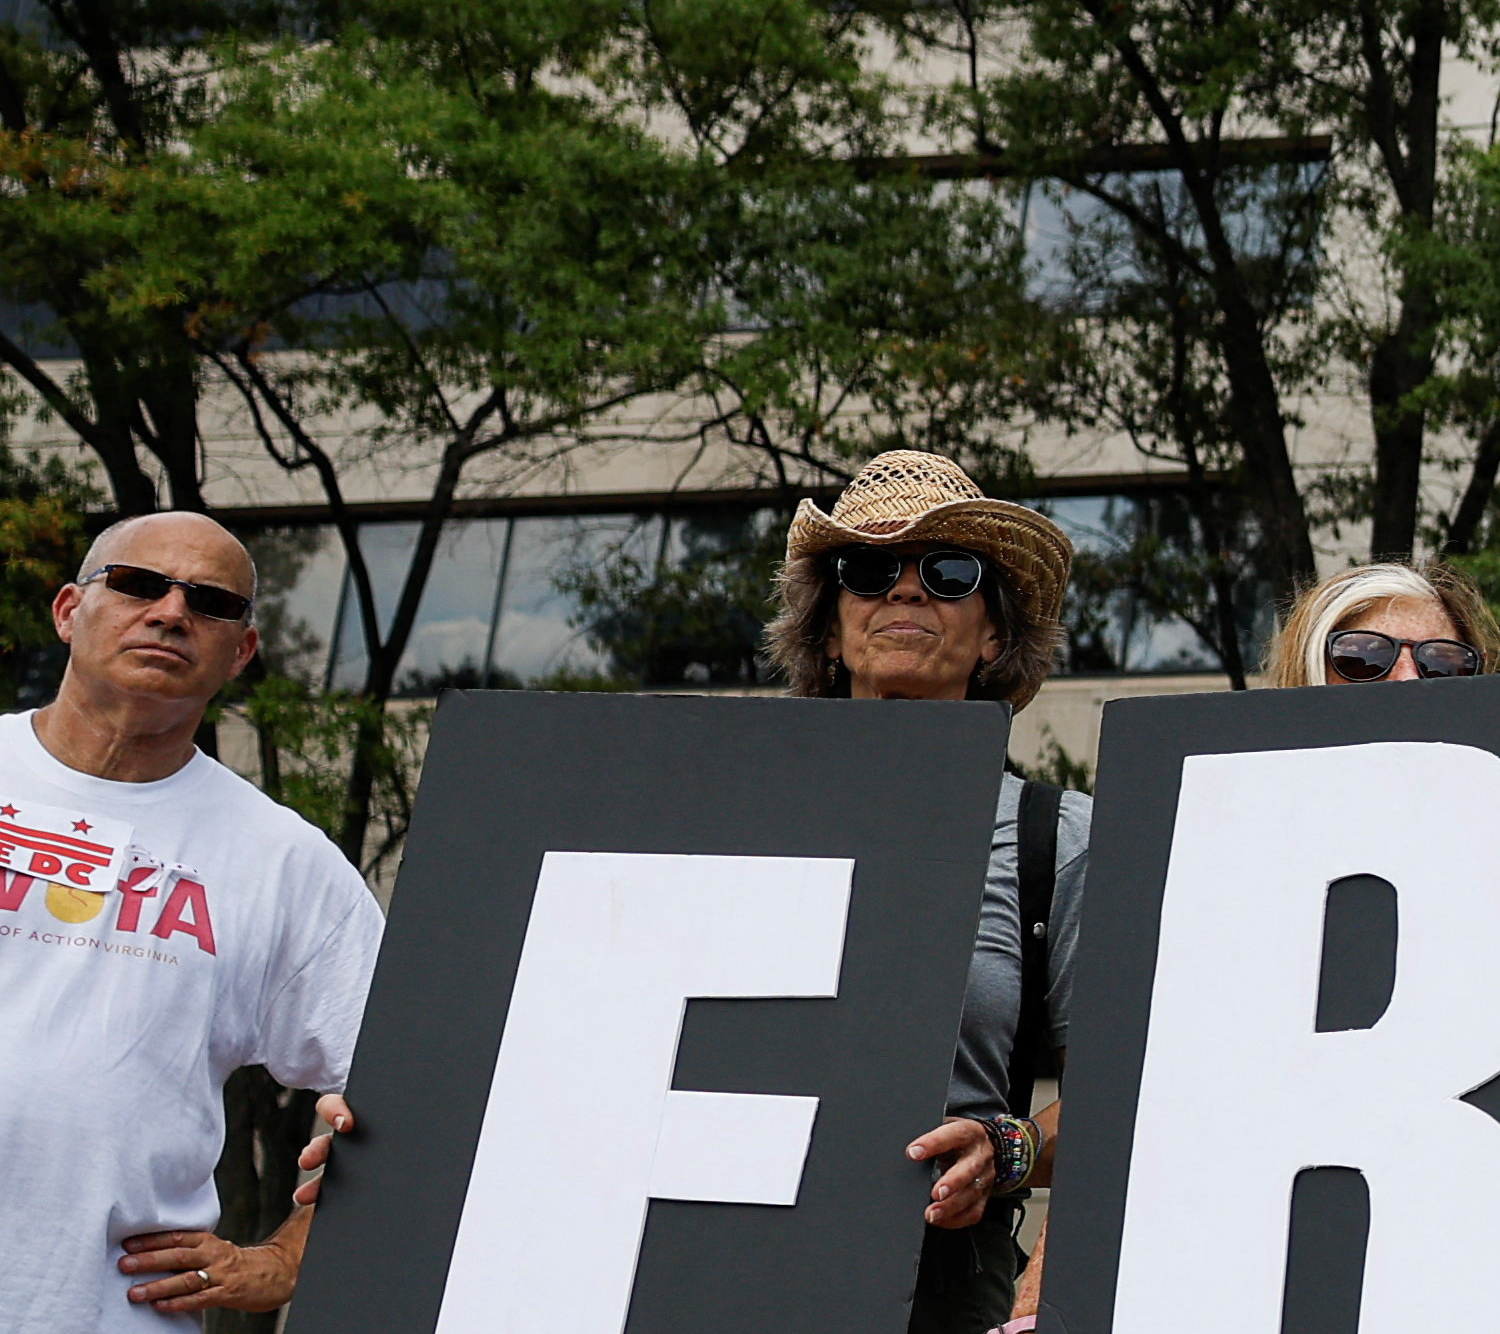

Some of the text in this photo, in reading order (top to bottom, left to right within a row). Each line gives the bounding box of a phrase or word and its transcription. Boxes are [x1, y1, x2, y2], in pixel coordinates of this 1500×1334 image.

[28, 851, 97, 886] DC
[29, 930, 101, 950] ACTION
[104, 940, 180, 967] VIRGINIA
